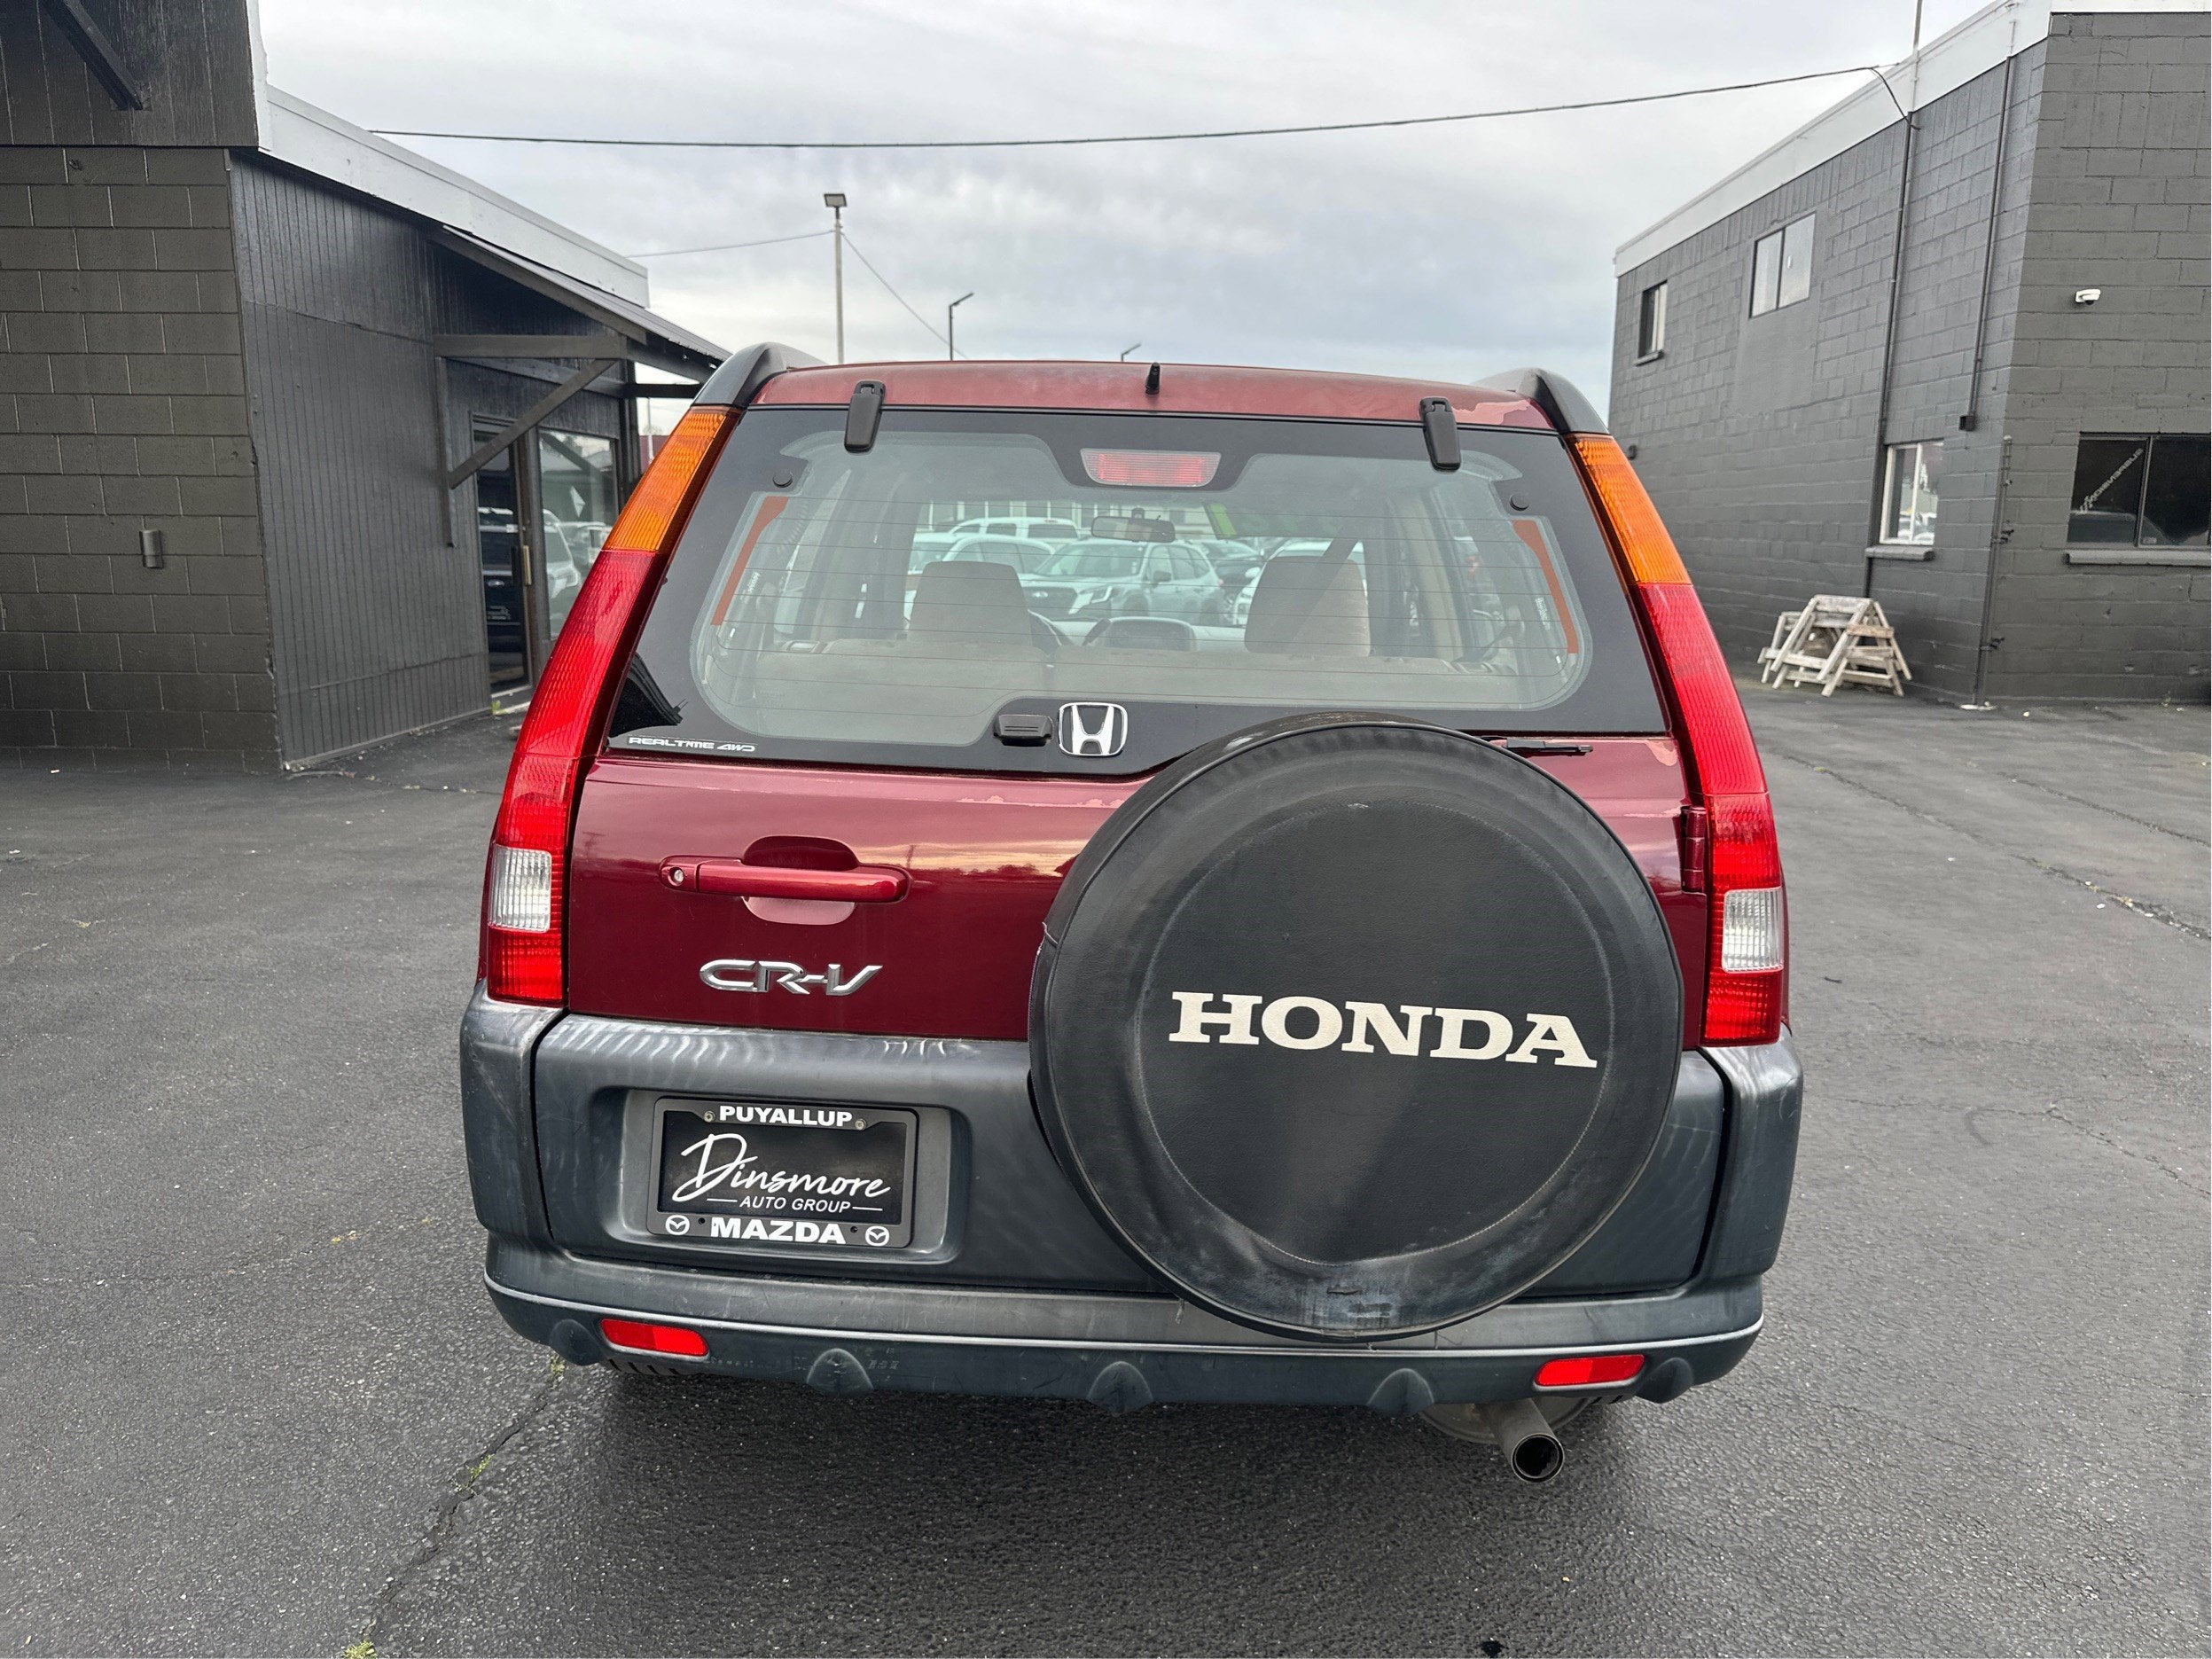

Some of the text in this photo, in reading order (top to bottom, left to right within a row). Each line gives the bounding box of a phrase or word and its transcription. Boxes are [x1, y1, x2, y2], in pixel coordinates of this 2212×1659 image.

[700, 959, 884, 996] CR-V
[1169, 991, 1598, 1068] HONDA
[719, 1105, 853, 1127] PUYALLUP
[671, 1132, 891, 1202] Dinsmore
[739, 1195, 851, 1213] AUTO GROUP
[710, 1217, 847, 1245] MAZDA
